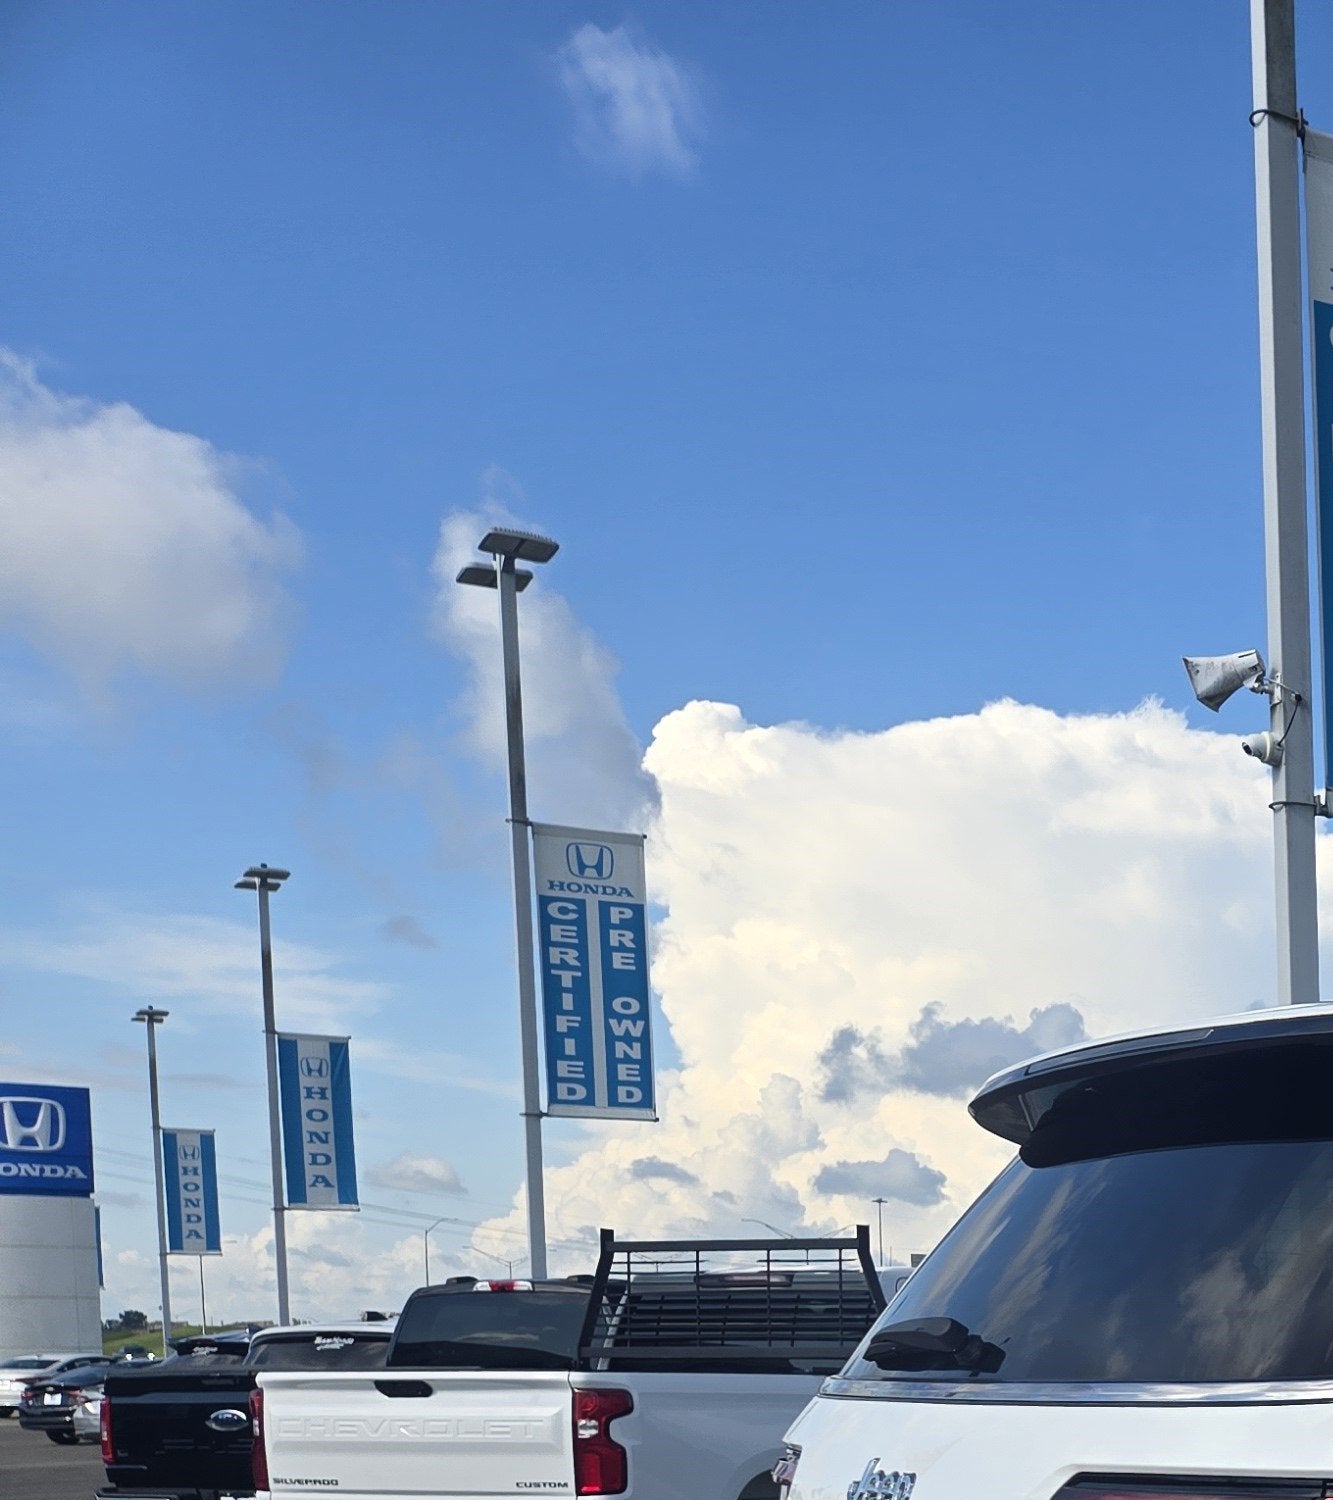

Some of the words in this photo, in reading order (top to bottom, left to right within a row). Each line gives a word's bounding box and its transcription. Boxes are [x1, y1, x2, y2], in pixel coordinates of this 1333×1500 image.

[547, 879, 635, 898] HONDA
[609, 905, 637, 971] PRE
[547, 900, 588, 1102] CERTIFIED
[608, 996, 645, 1104] OWNED
[303, 1086, 335, 1188] HONDA
[0, 1162, 88, 1179] ONDA
[181, 1166, 204, 1240] HONDA
[277, 1417, 544, 1440] CHEVROLET
[272, 1477, 339, 1488] SILVERADO
[515, 1480, 569, 1490] CUSTOM
